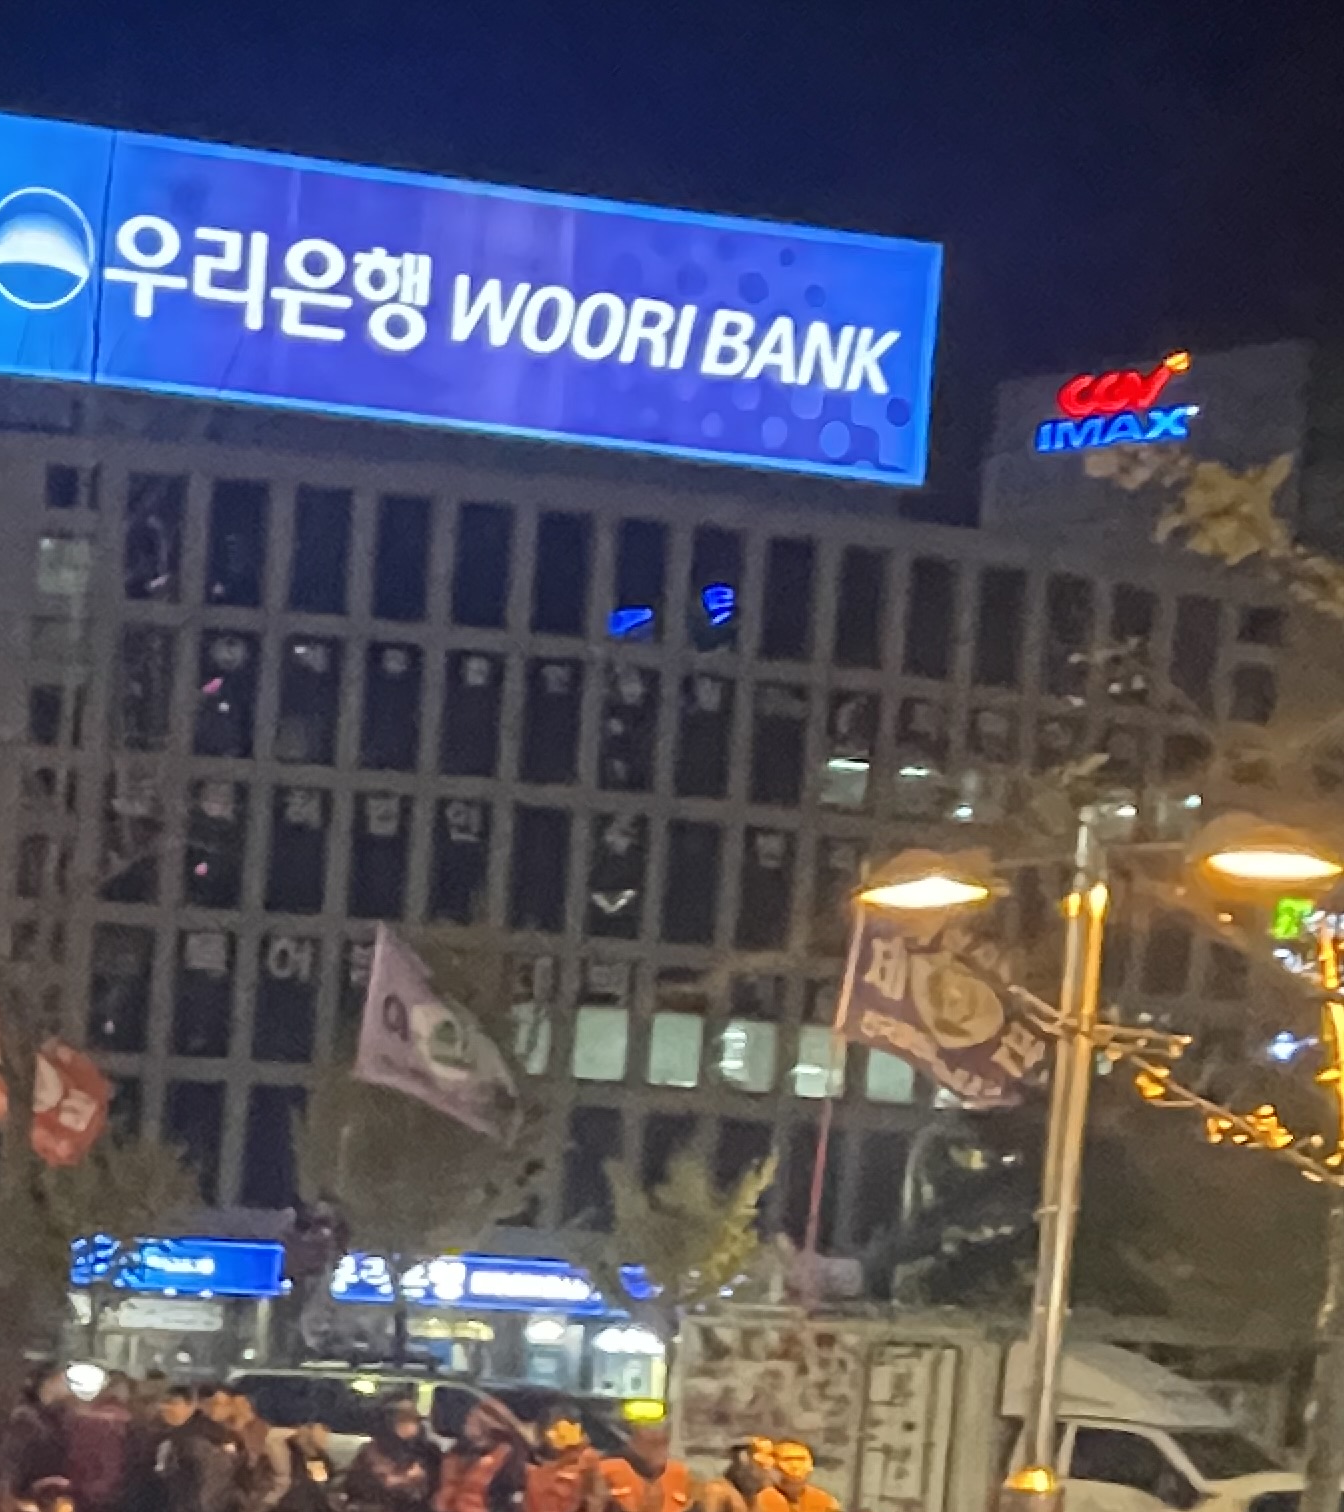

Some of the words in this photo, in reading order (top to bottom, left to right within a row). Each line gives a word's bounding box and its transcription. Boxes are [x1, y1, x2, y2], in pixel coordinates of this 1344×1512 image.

[104, 214, 432, 352] 우리은행
[450, 274, 692, 371] WOORI
[699, 308, 903, 395] BANK
[1034, 405, 1192, 453] IMAX
